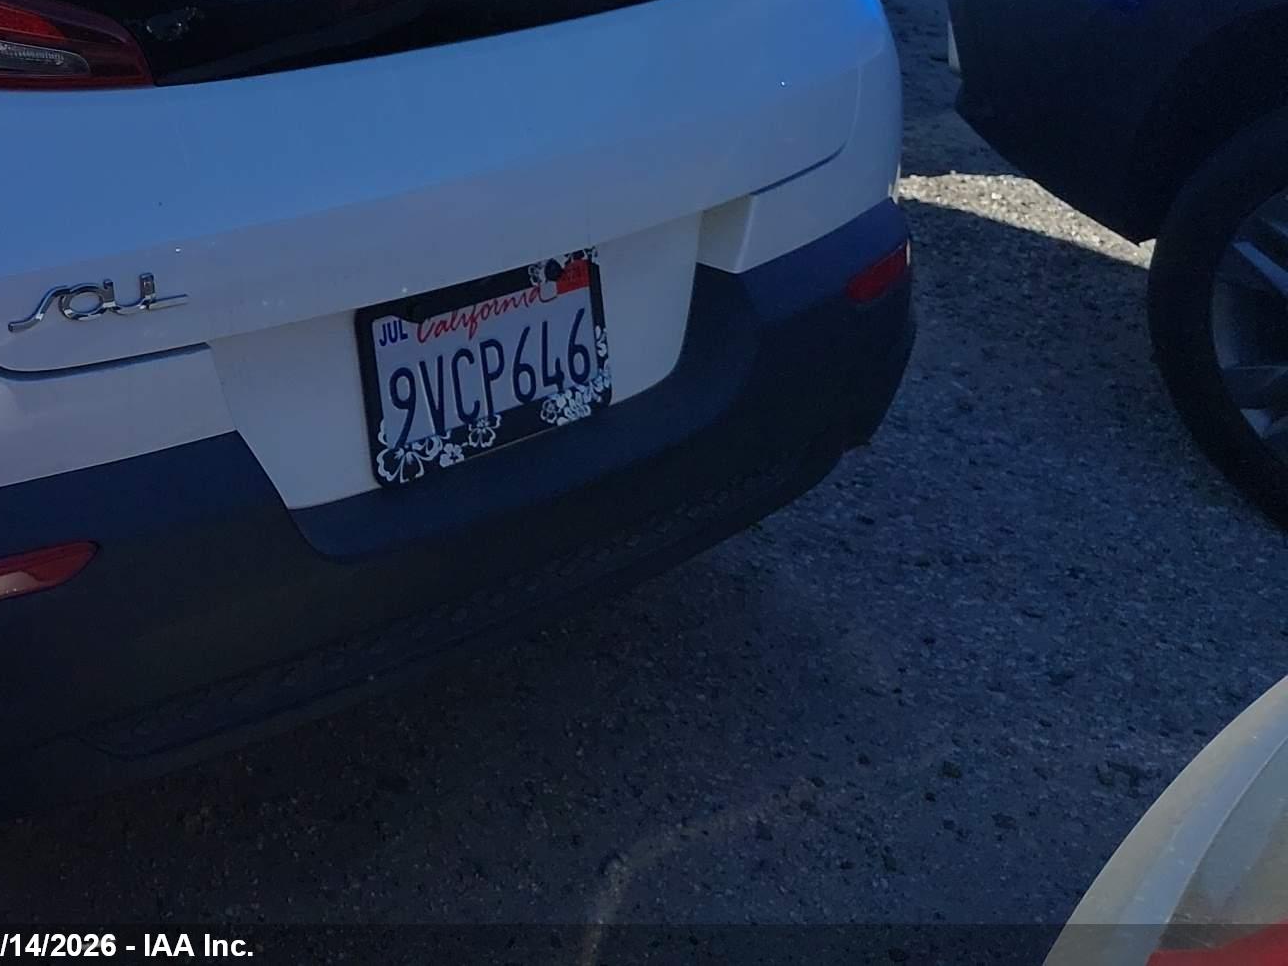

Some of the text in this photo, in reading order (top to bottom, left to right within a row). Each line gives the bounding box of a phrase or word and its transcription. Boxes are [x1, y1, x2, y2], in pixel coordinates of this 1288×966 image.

[378, 318, 409, 347] JUL
[415, 284, 558, 345] California
[388, 307, 591, 450] 9VCP646
